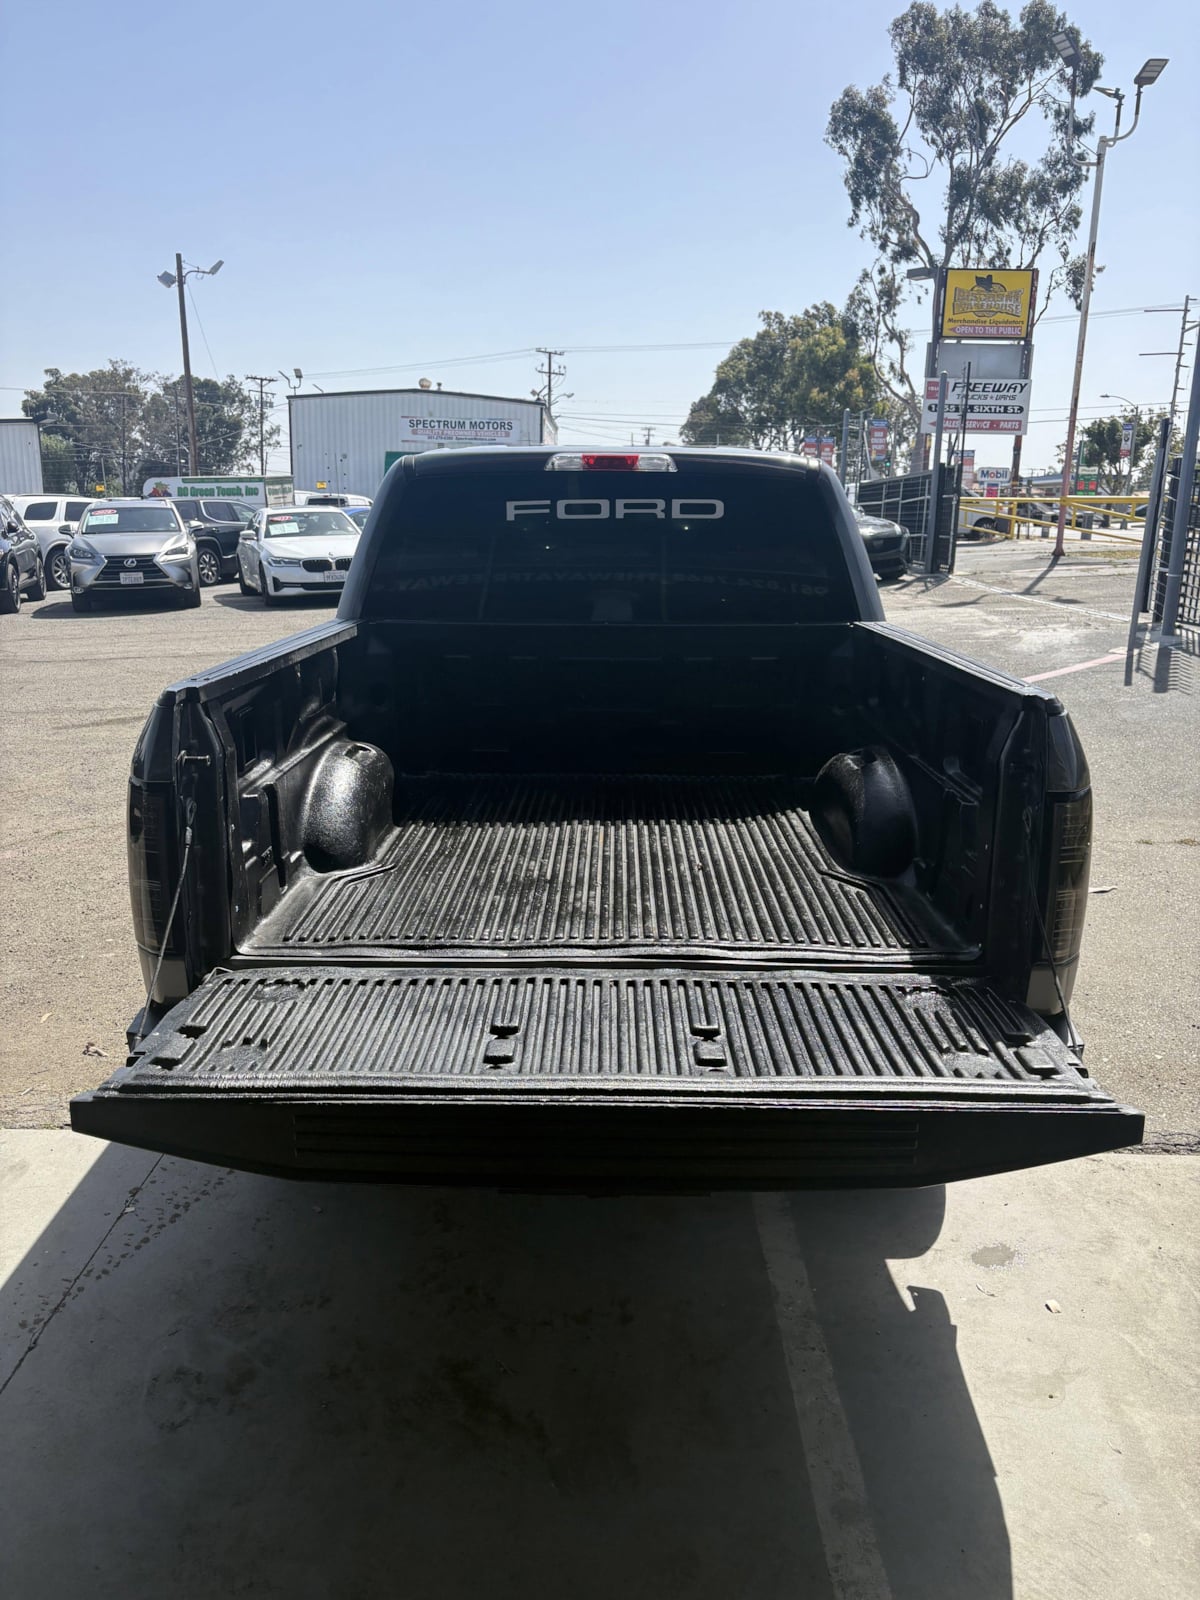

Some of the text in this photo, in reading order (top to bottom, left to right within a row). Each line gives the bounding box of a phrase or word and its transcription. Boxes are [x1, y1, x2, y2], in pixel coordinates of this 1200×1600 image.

[947, 317, 1024, 326] Merchandise Liquidators
[999, 327, 1021, 335] PUBLIC
[952, 382, 1029, 393] FREEWAY
[931, 405, 956, 413] 155
[1006, 406, 1021, 414] ST.
[408, 419, 513, 431] SPECTRUM MOTORS
[965, 421, 991, 429] SERVICE
[980, 469, 1008, 479] Mobil
[190, 486, 215, 497] Green
[216, 486, 244, 498] Touch,
[245, 485, 259, 496] Inc
[506, 498, 725, 521] FORD
